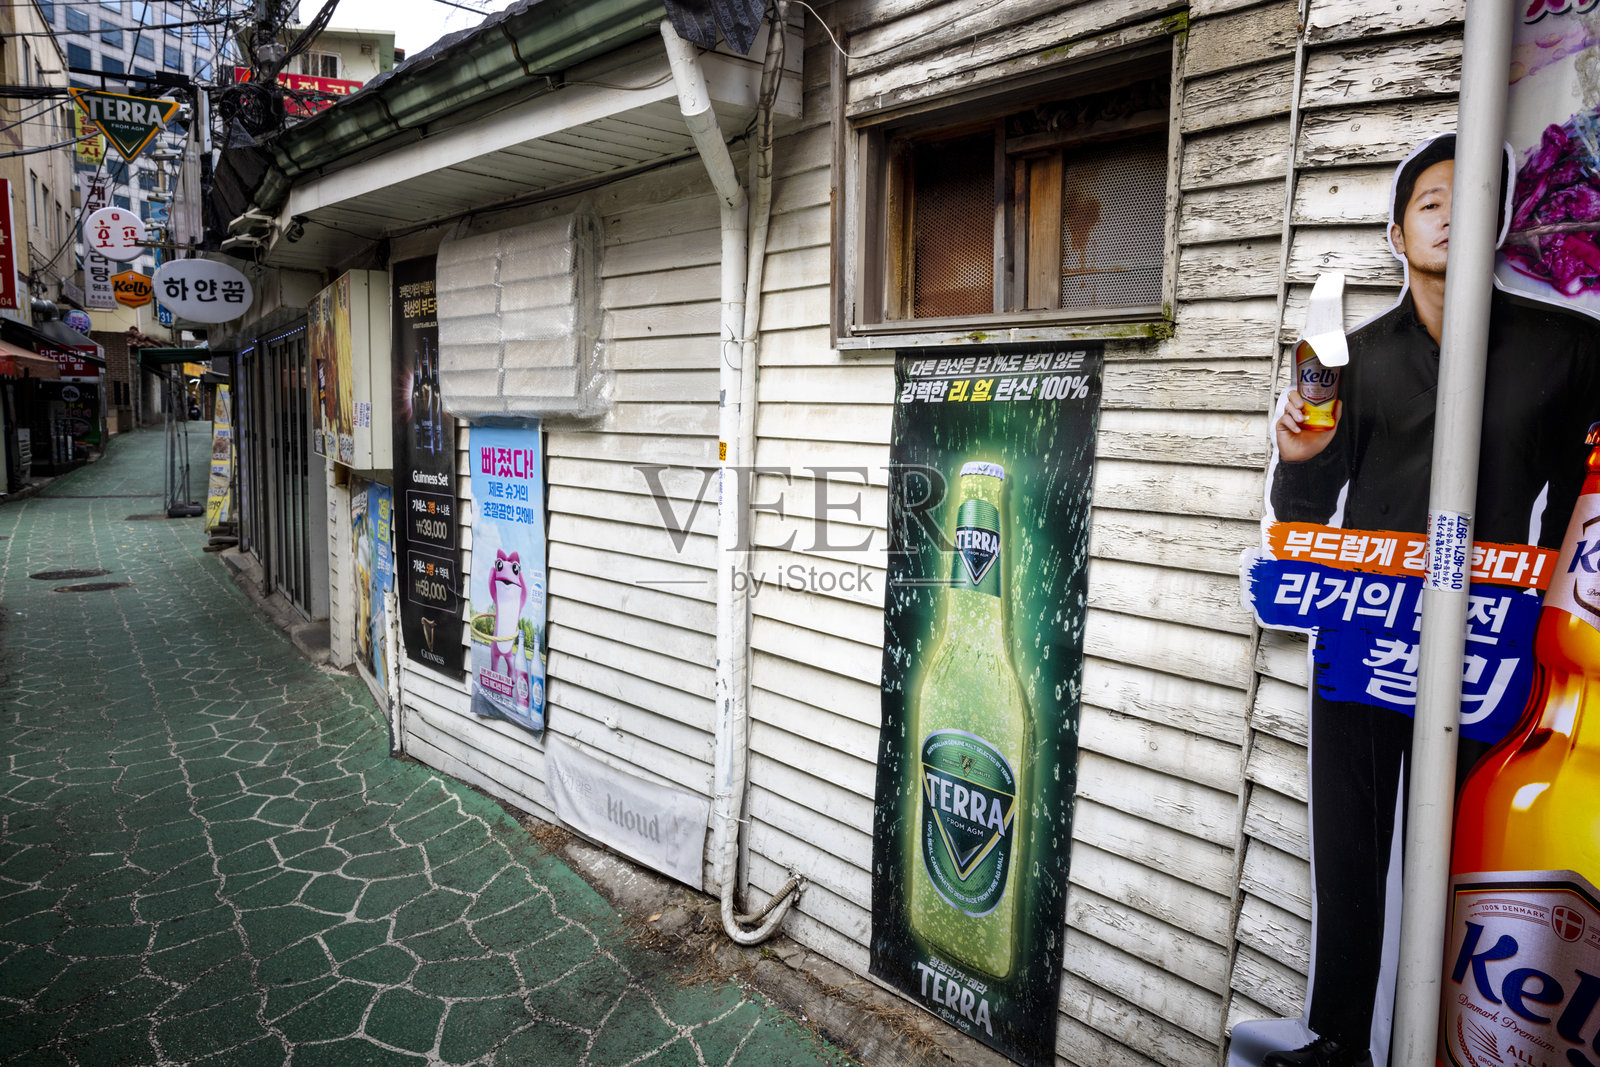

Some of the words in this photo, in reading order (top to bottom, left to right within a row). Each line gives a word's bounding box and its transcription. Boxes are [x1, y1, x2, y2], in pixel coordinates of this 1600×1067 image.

[83, 95, 164, 129] TERRA
[94, 219, 139, 248] 호프
[113, 280, 153, 297] Kelly
[163, 276, 246, 304] 하얀꿈
[404, 298, 421, 319] 천상의
[909, 359, 937, 376] 다른
[935, 357, 977, 375] 탄산은
[974, 356, 992, 374] 단
[1052, 350, 1087, 370] 않은
[900, 380, 949, 403] 강력한
[993, 377, 1038, 401] 탄산
[1038, 375, 1090, 400] 100%
[1300, 368, 1338, 388] Kelly
[481, 446, 534, 480] 빠졌다!
[412, 470, 438, 485] Guinness
[437, 472, 449, 486] Set
[488, 481, 504, 498] 제로
[505, 483, 529, 502] 슈거의
[412, 498, 427, 513] 기네스
[483, 501, 515, 522] 초깔끔한
[516, 506, 534, 525] 맛에!
[415, 518, 448, 540] ₩39,000
[956, 529, 999, 557] TERRA
[1284, 530, 1396, 567] 부드럽게
[1450, 515, 1470, 590] 010-4671-9977
[412, 559, 426, 573] 기네스
[415, 580, 447, 602] ₩59,000
[1274, 572, 1406, 629] 라거의
[421, 648, 445, 666] GUINNESS
[973, 768, 991, 778] QUALITY
[926, 772, 1005, 837] TERRA
[946, 817, 965, 831] FROM
[967, 826, 984, 837] AGM
[996, 851, 1004, 871] MALT
[1502, 905, 1546, 919] DENMARK
[917, 961, 993, 1038] TERRA
[937, 1007, 955, 1022] FROM
[956, 1020, 971, 1031] AGM
[1457, 993, 1499, 1024] Denmark
[1501, 1016, 1555, 1054] Premium
